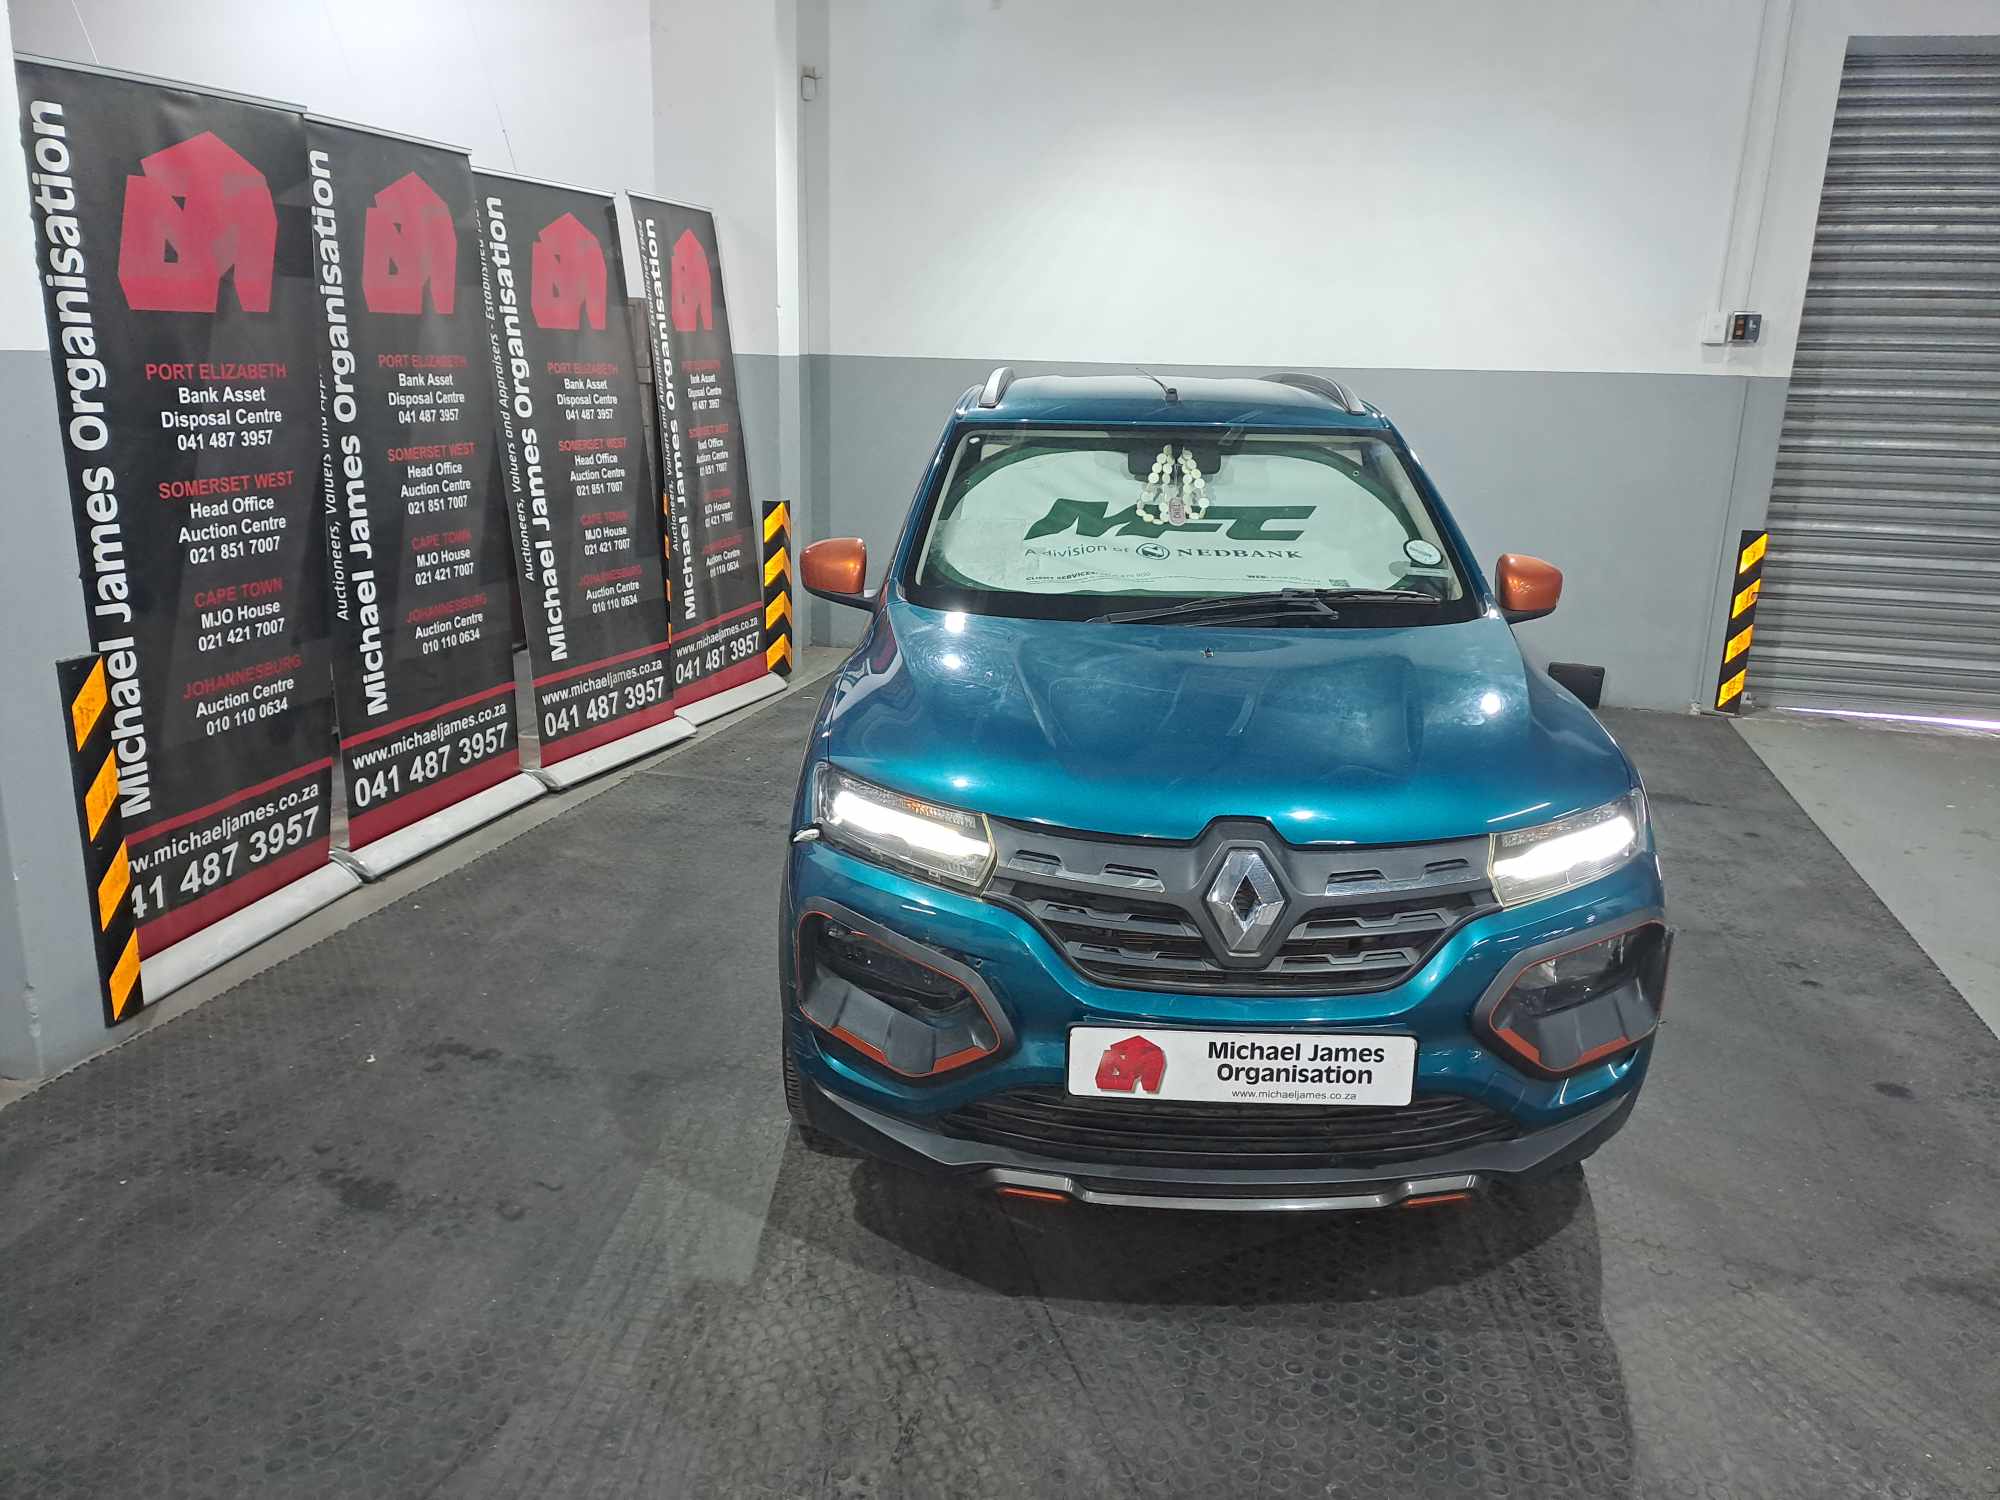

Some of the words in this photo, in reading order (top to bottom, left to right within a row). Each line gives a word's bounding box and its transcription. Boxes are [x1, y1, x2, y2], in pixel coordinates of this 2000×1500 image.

[30, 100, 109, 451] Organisation
[309, 150, 357, 423] Organisation
[486, 196, 534, 419] Organisation
[645, 218, 676, 411] Organisation
[146, 364, 193, 381] PORT
[200, 363, 287, 380] ELIZABETH
[398, 373, 425, 387] Bank
[427, 373, 454, 386] Asset
[489, 333, 510, 407] Appraisers
[564, 378, 584, 389] Bank
[179, 387, 219, 403] Bank
[223, 386, 266, 402] Asset
[388, 391, 433, 407] Disposal
[435, 391, 465, 404] Centre
[556, 393, 591, 407] Disposal
[161, 410, 230, 430] Disposal
[235, 408, 282, 424] Centre
[398, 410, 416, 424] 041
[419, 409, 436, 423] 487
[439, 408, 459, 422] 3957
[503, 413, 513, 439] and
[177, 434, 204, 450] 041
[209, 431, 235, 448] 487
[241, 430, 273, 446] 3957
[407, 464, 433, 479] Head
[436, 462, 463, 476] Office
[506, 442, 523, 493] Valuers
[570, 470, 600, 482] Auction
[670, 419, 687, 509] James
[159, 476, 249, 499] SOMERSET
[254, 470, 295, 489] WEST
[401, 482, 440, 498] Auction
[442, 479, 471, 493] Centre
[521, 428, 551, 531] James
[190, 500, 228, 519] Head
[232, 495, 274, 513] Office
[341, 435, 373, 559] James
[408, 501, 425, 515] 021
[428, 498, 445, 512] 851
[447, 495, 468, 509] 7007
[82, 466, 131, 622] James
[179, 522, 237, 543] Auction
[241, 516, 286, 534] Centre
[516, 498, 535, 582] Auctioneers,
[189, 548, 215, 565] 021
[221, 541, 245, 559] 851
[249, 536, 281, 555] 7007
[416, 552, 438, 568] MJO
[441, 548, 471, 563] House
[1177, 548, 1303, 559] NEDBANK
[330, 520, 349, 620] Auctioneers,
[415, 570, 432, 586] 021
[434, 567, 451, 581] 421
[453, 562, 474, 578] 7007
[679, 515, 697, 620] Michael
[194, 586, 235, 608] CAPE
[241, 578, 283, 597] TOWN
[535, 541, 568, 662] Michael
[586, 586, 615, 601] Auction
[200, 608, 233, 629] MJO
[237, 601, 281, 621] House
[415, 620, 451, 639] Auction
[454, 612, 483, 628] Centre
[198, 634, 223, 652] 021
[227, 625, 251, 646] 421
[255, 618, 285, 639] 7007
[351, 569, 388, 716] Michael
[422, 639, 439, 655] 010
[441, 634, 457, 649] 110
[459, 628, 480, 644] 0634
[676, 656, 700, 684] 041
[705, 645, 725, 671] 487
[730, 631, 760, 660] 3957
[182, 654, 304, 700] JOHANNESBURG
[542, 659, 663, 707] www.michaeljames.co.za
[195, 692, 249, 719] Auction
[253, 677, 294, 704] Centre
[544, 704, 580, 738] 041
[586, 691, 620, 724] 487
[625, 675, 665, 711] 3957
[99, 636, 152, 819] Michael
[206, 717, 230, 737] 010
[234, 708, 256, 731] 110
[259, 699, 288, 724] 0634
[353, 702, 507, 771] www.michaeljames.co.za
[354, 765, 401, 808] 041
[409, 744, 451, 784] 487
[459, 721, 509, 765] 3957
[129, 783, 319, 876] w.michaeljames.co.za
[131, 876, 165, 920] 41
[180, 841, 240, 895] 487
[249, 805, 320, 865] 3957
[1208, 1041, 1301, 1061] Michael
[1307, 1042, 1385, 1063] James
[1217, 1062, 1373, 1086] Organisation
[1231, 1089, 1357, 1101] www.michaeljames.co.za
